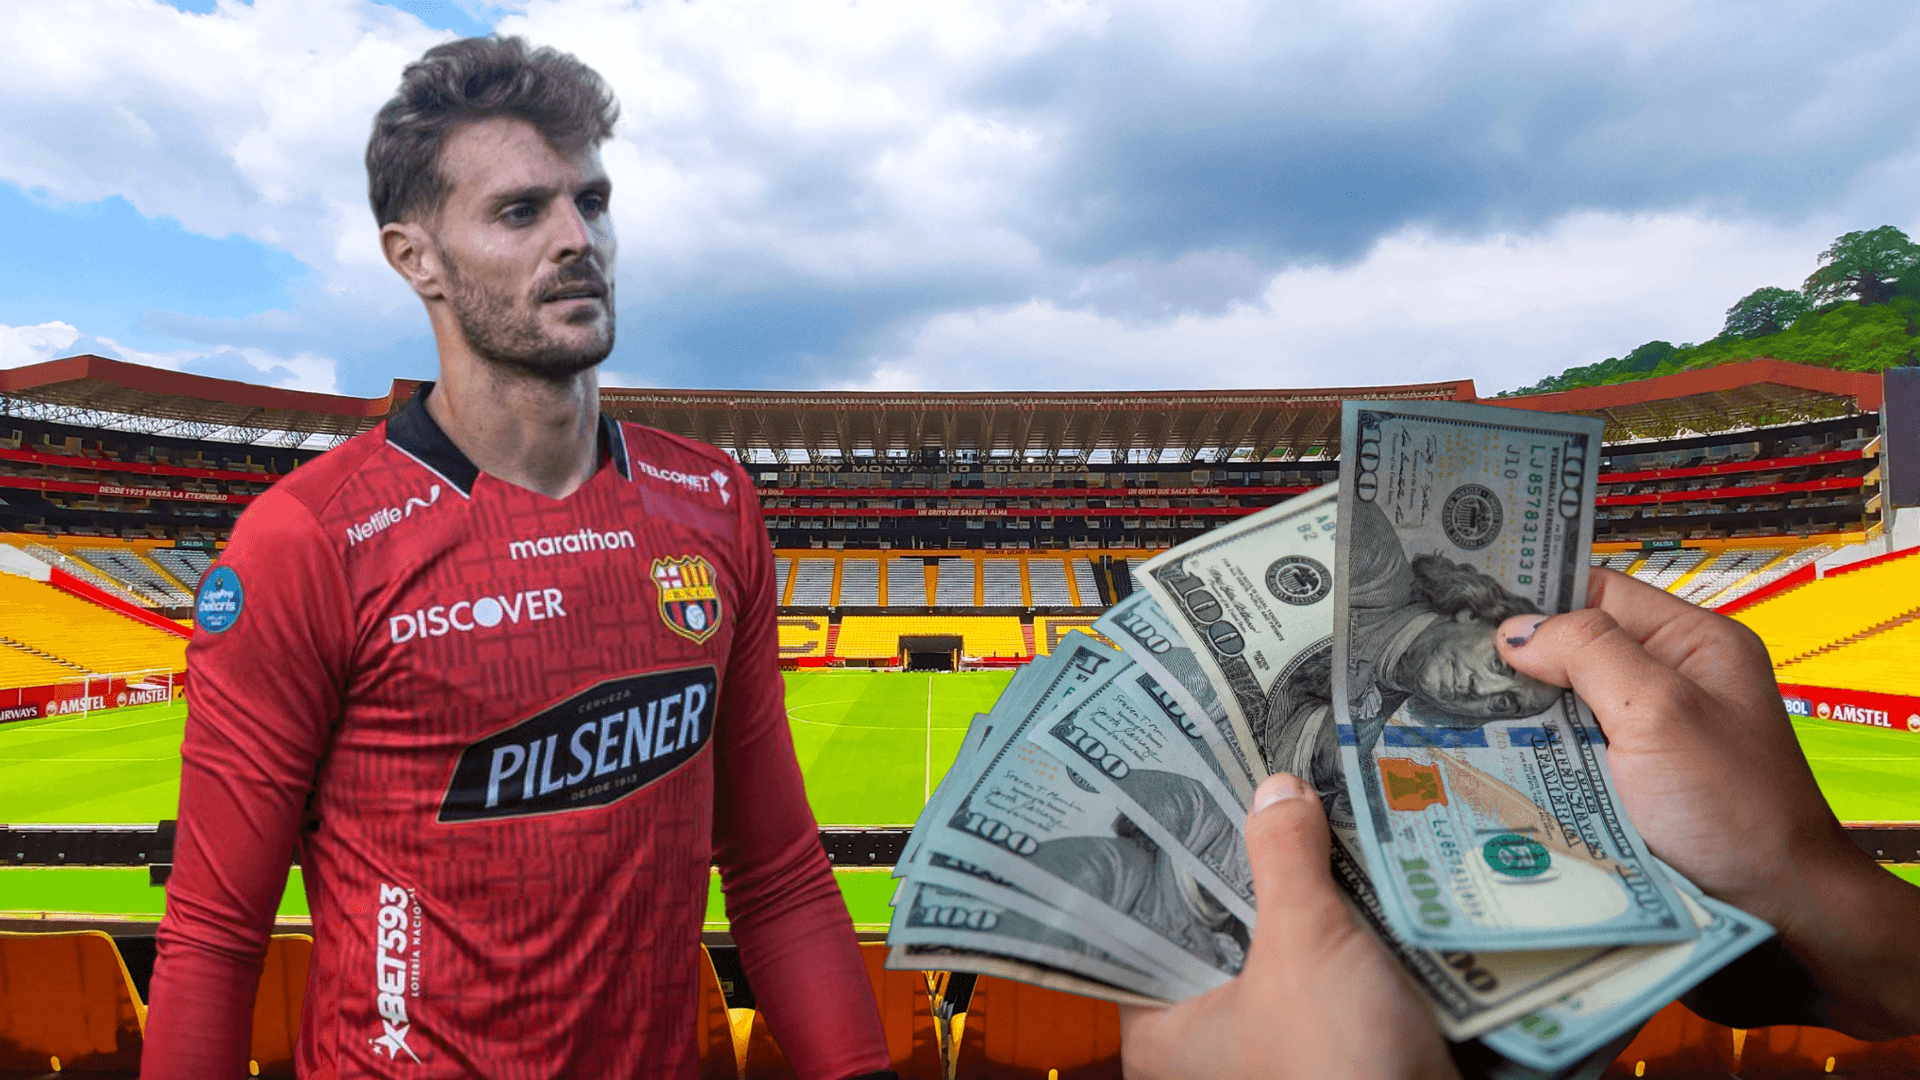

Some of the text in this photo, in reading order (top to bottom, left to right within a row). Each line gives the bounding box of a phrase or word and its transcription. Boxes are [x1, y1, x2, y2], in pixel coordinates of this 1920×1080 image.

[1355, 423, 1381, 503] 100
[1504, 444, 1520, 479] J10
[1557, 439, 1586, 519] 100
[146, 489, 172, 498] HASTA
[185, 492, 228, 501] ETERNIDAD
[345, 504, 402, 547] Netlife
[509, 528, 636, 560] marathon
[1536, 446, 1559, 606] FEDERAL RESERVE NOTE
[1652, 540, 1674, 549] SALIDA
[389, 587, 567, 644] DISCOVER
[1167, 571, 1245, 655] 100
[1261, 611, 1270, 620] AND
[1269, 621, 1284, 641] PRIVATE
[1266, 609, 1281, 628] TENDER
[1122, 612, 1172, 654] 100
[0, 706, 38, 721] IRWAYS
[59, 696, 106, 715] AMSTEL
[128, 689, 168, 705] AMSTEL
[578, 689, 632, 714] CERVEZA
[1783, 699, 1808, 715] BOL
[1832, 704, 1892, 727] AMSTEL
[485, 683, 707, 809] PILSENER
[1066, 724, 1130, 780] 100
[1224, 729, 1252, 772] FRANKLIN
[571, 783, 610, 801] DESDE
[1531, 775, 1539, 788] NOTE
[1542, 719, 1607, 858] UNITED STATES
[1537, 761, 1582, 847] AMERICA
[963, 812, 1039, 857] 100
[1399, 856, 1452, 927] 100
[922, 905, 998, 932] 100
[1443, 950, 1498, 993] 00
